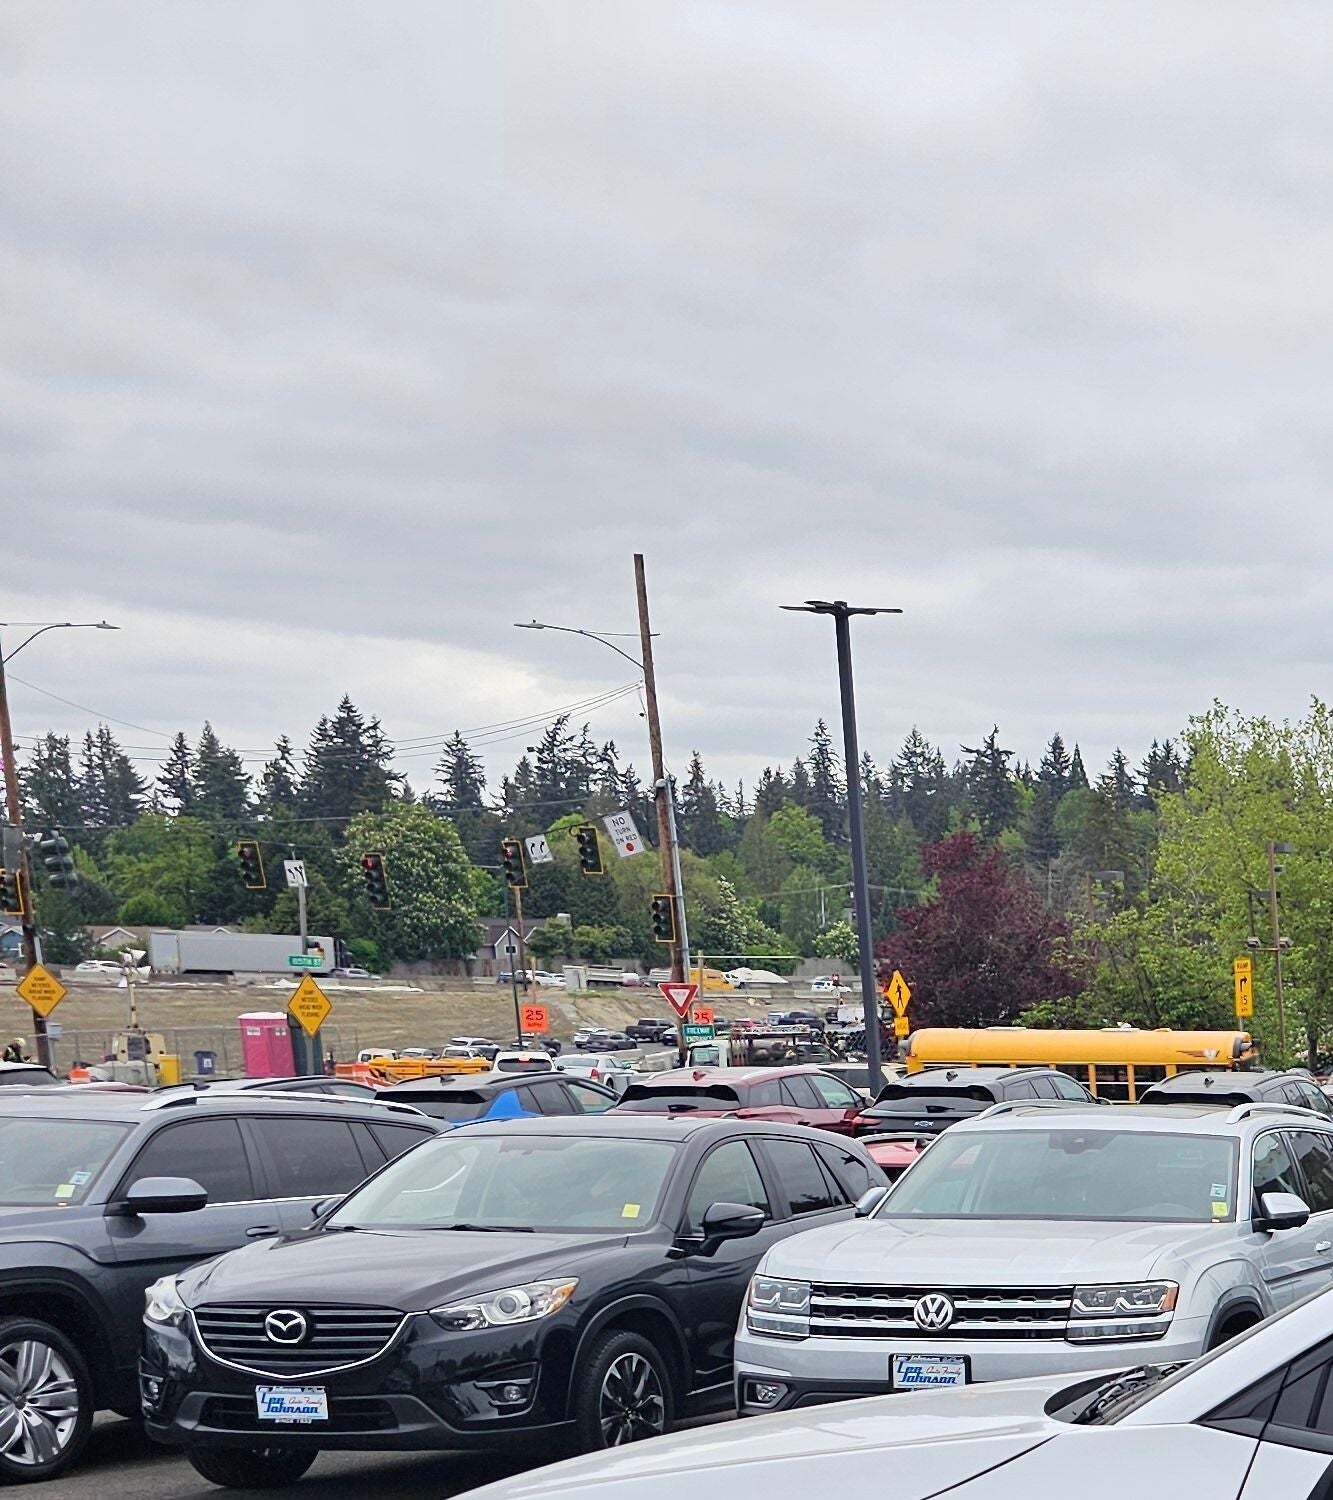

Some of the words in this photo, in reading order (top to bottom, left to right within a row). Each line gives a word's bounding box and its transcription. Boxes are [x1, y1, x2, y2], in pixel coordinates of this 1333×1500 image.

[611, 816, 626, 827] NO
[625, 833, 637, 841] RED
[525, 1009, 544, 1021] 25
[898, 1371, 958, 1384] Johnson
[263, 1402, 320, 1413] Johnson
